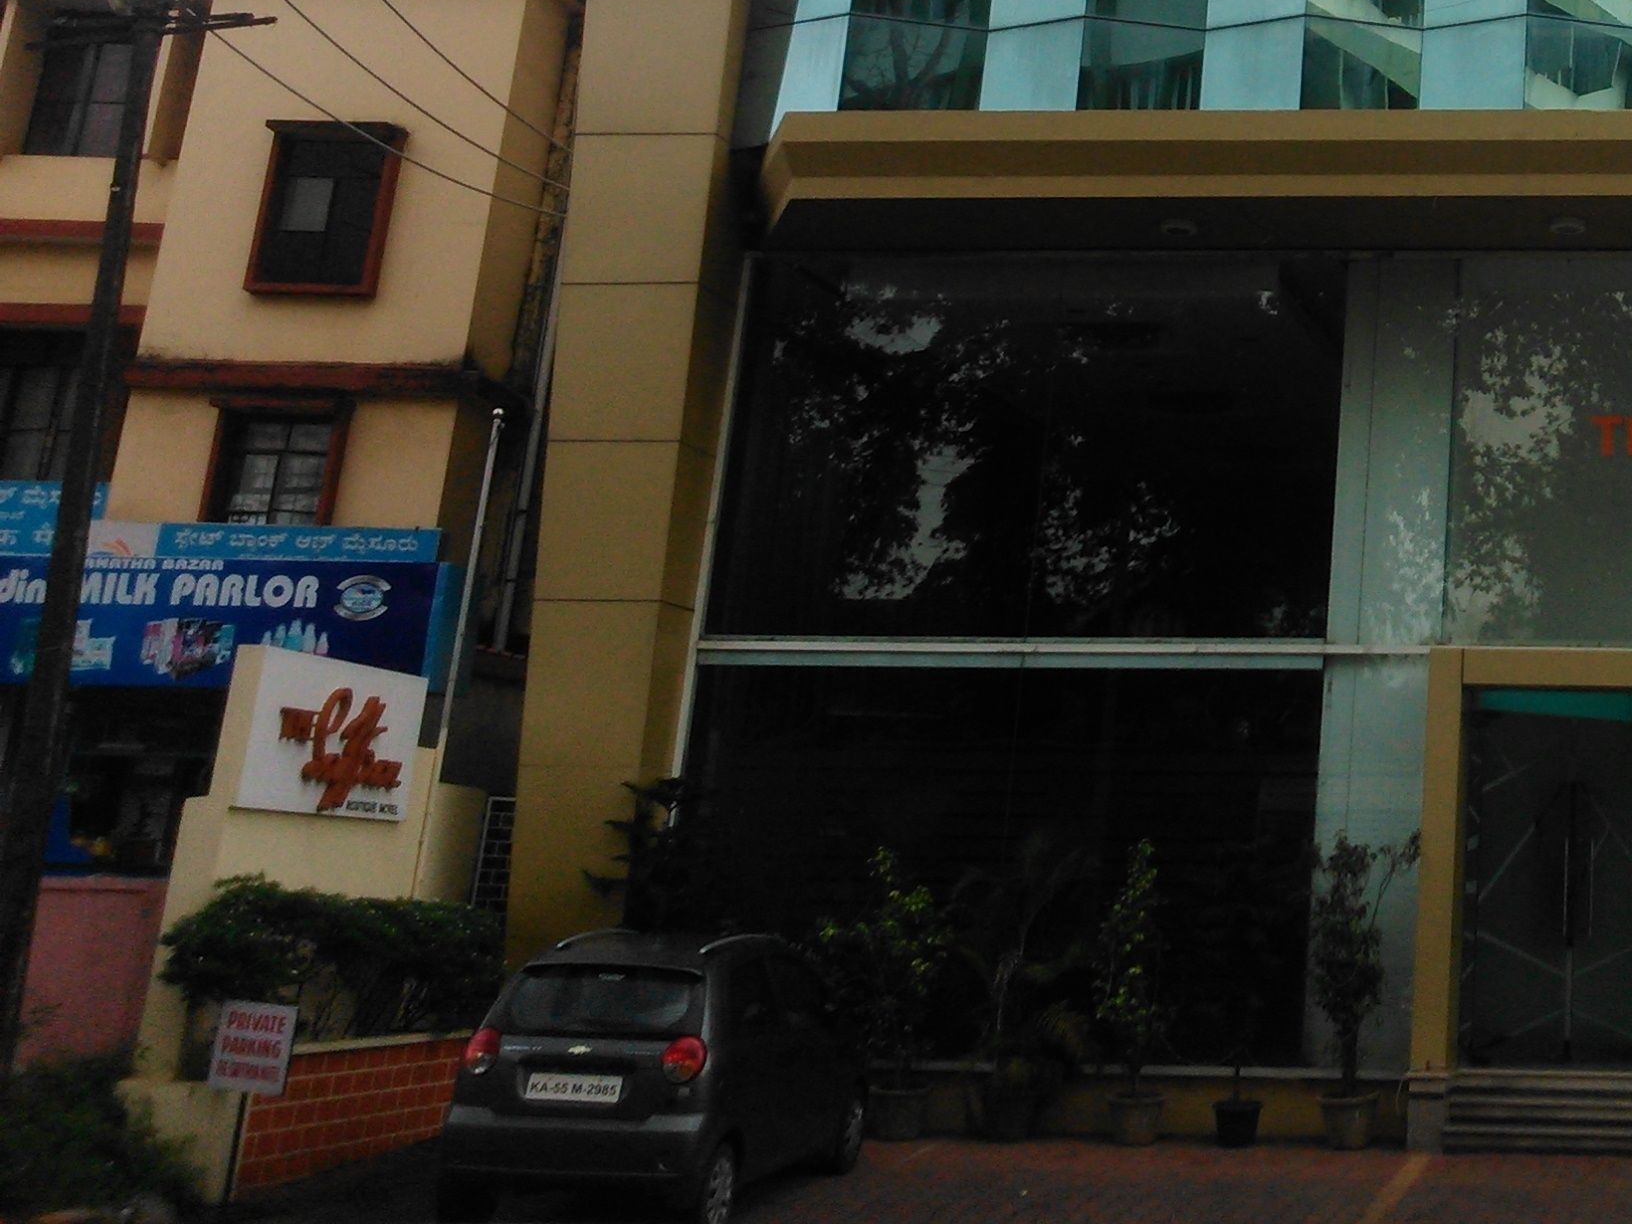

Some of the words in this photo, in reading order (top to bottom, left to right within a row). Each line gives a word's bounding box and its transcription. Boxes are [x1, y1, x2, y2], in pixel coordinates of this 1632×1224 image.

[162, 559, 225, 572] BAZAR
[0, 568, 48, 605] din
[170, 573, 320, 609] PARLOR
[227, 1010, 287, 1034] PRIVATE
[222, 1036, 282, 1060] PARKING
[530, 1081, 568, 1094] KA-55
